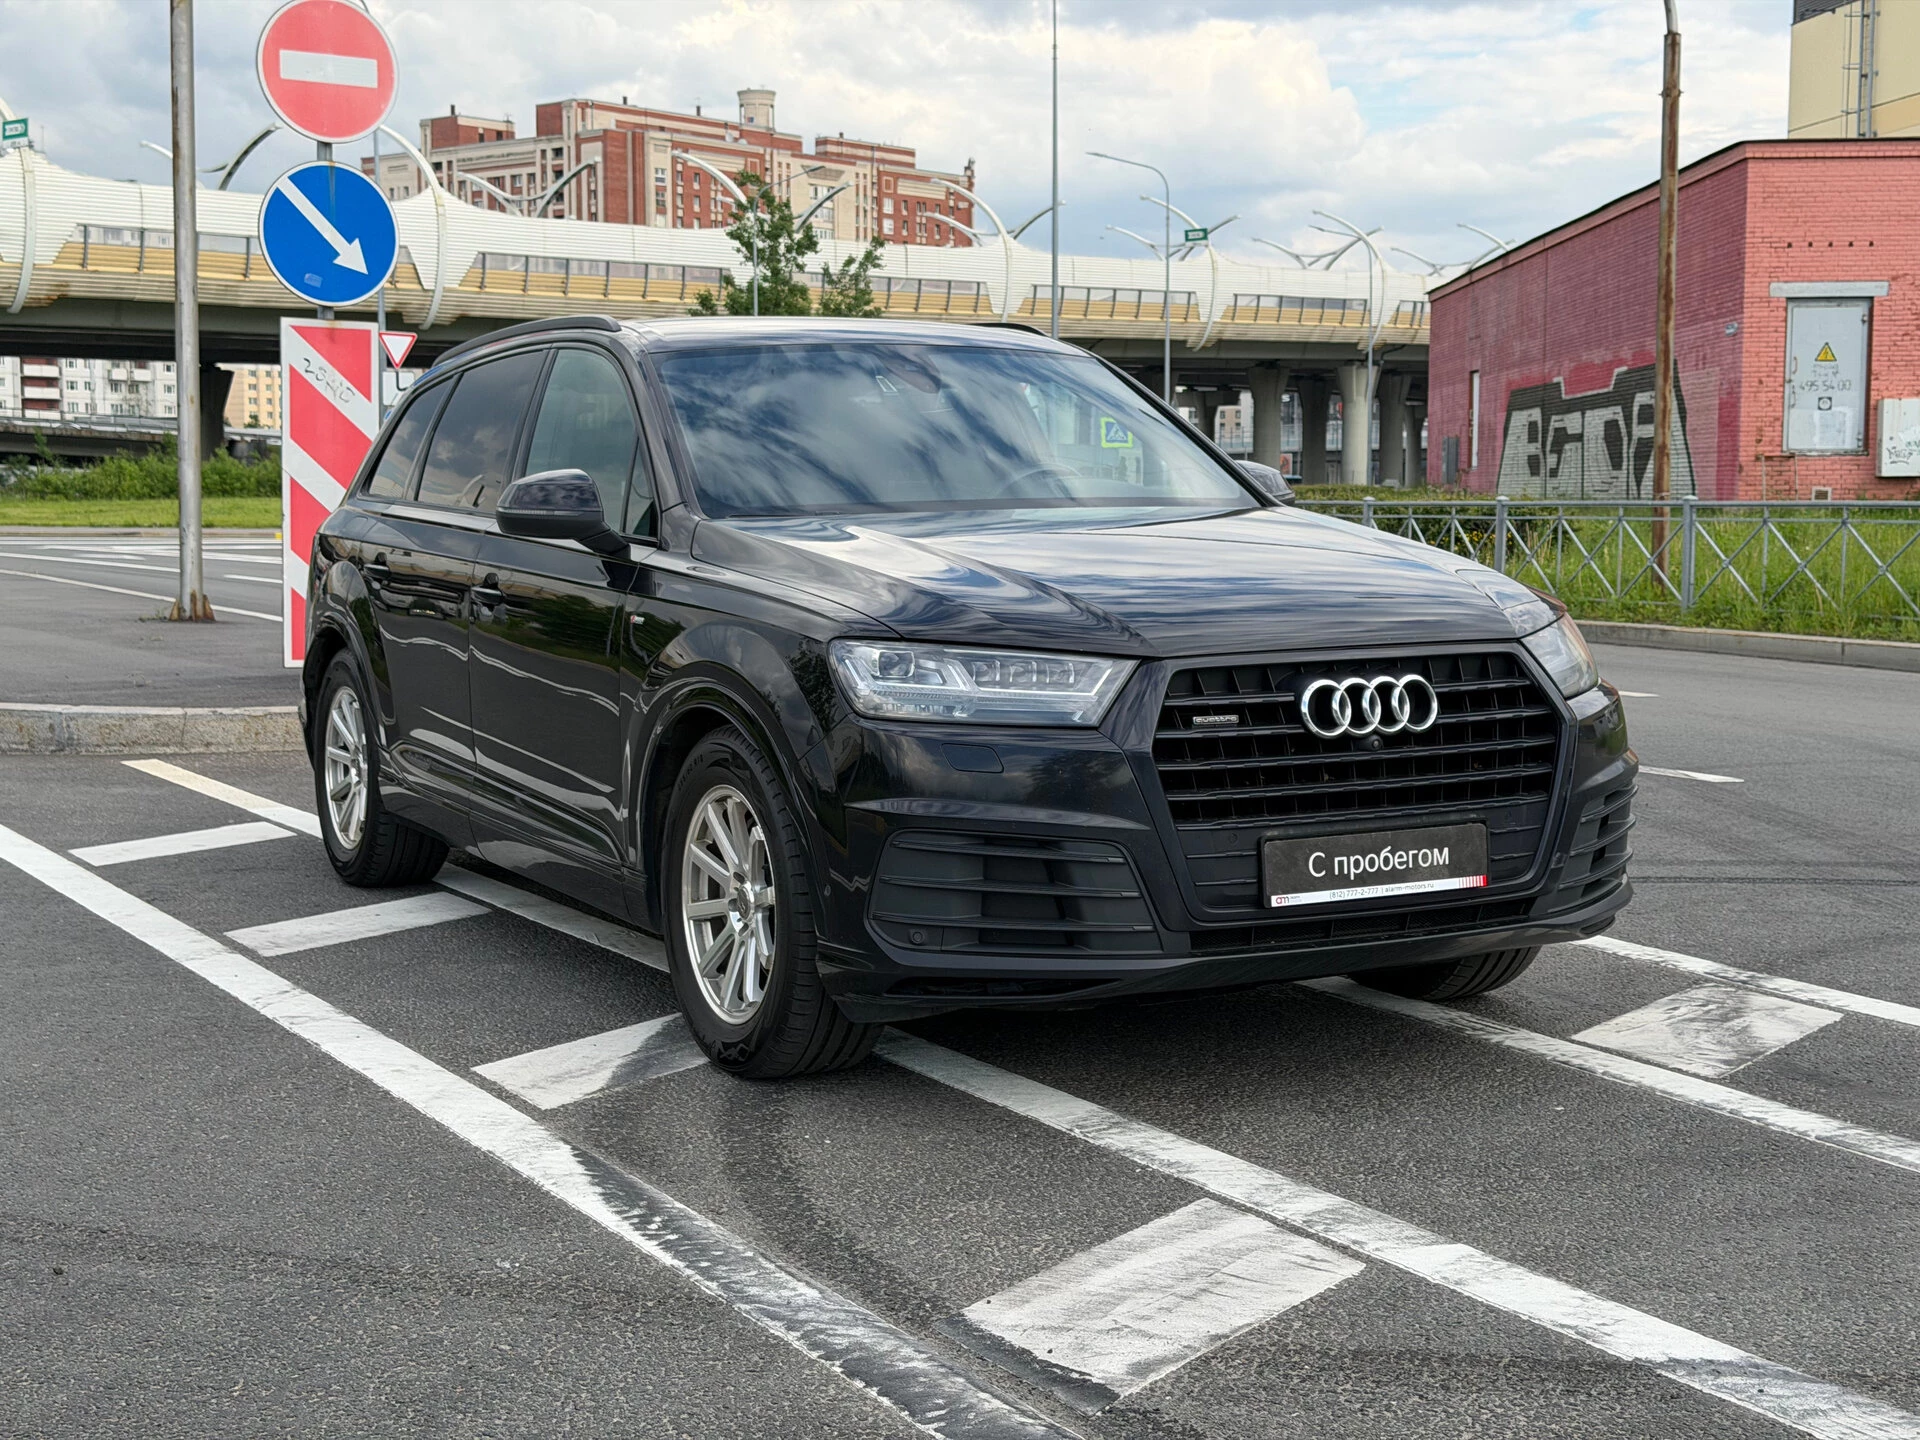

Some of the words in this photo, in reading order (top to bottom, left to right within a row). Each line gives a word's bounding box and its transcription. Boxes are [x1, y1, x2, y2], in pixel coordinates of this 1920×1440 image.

[1194, 715, 1239, 724] quattro
[1308, 851, 1326, 877] С
[1334, 845, 1450, 880] пробегом
[1329, 891, 1346, 899] (812)
[1346, 887, 1379, 897] 777-2-777
